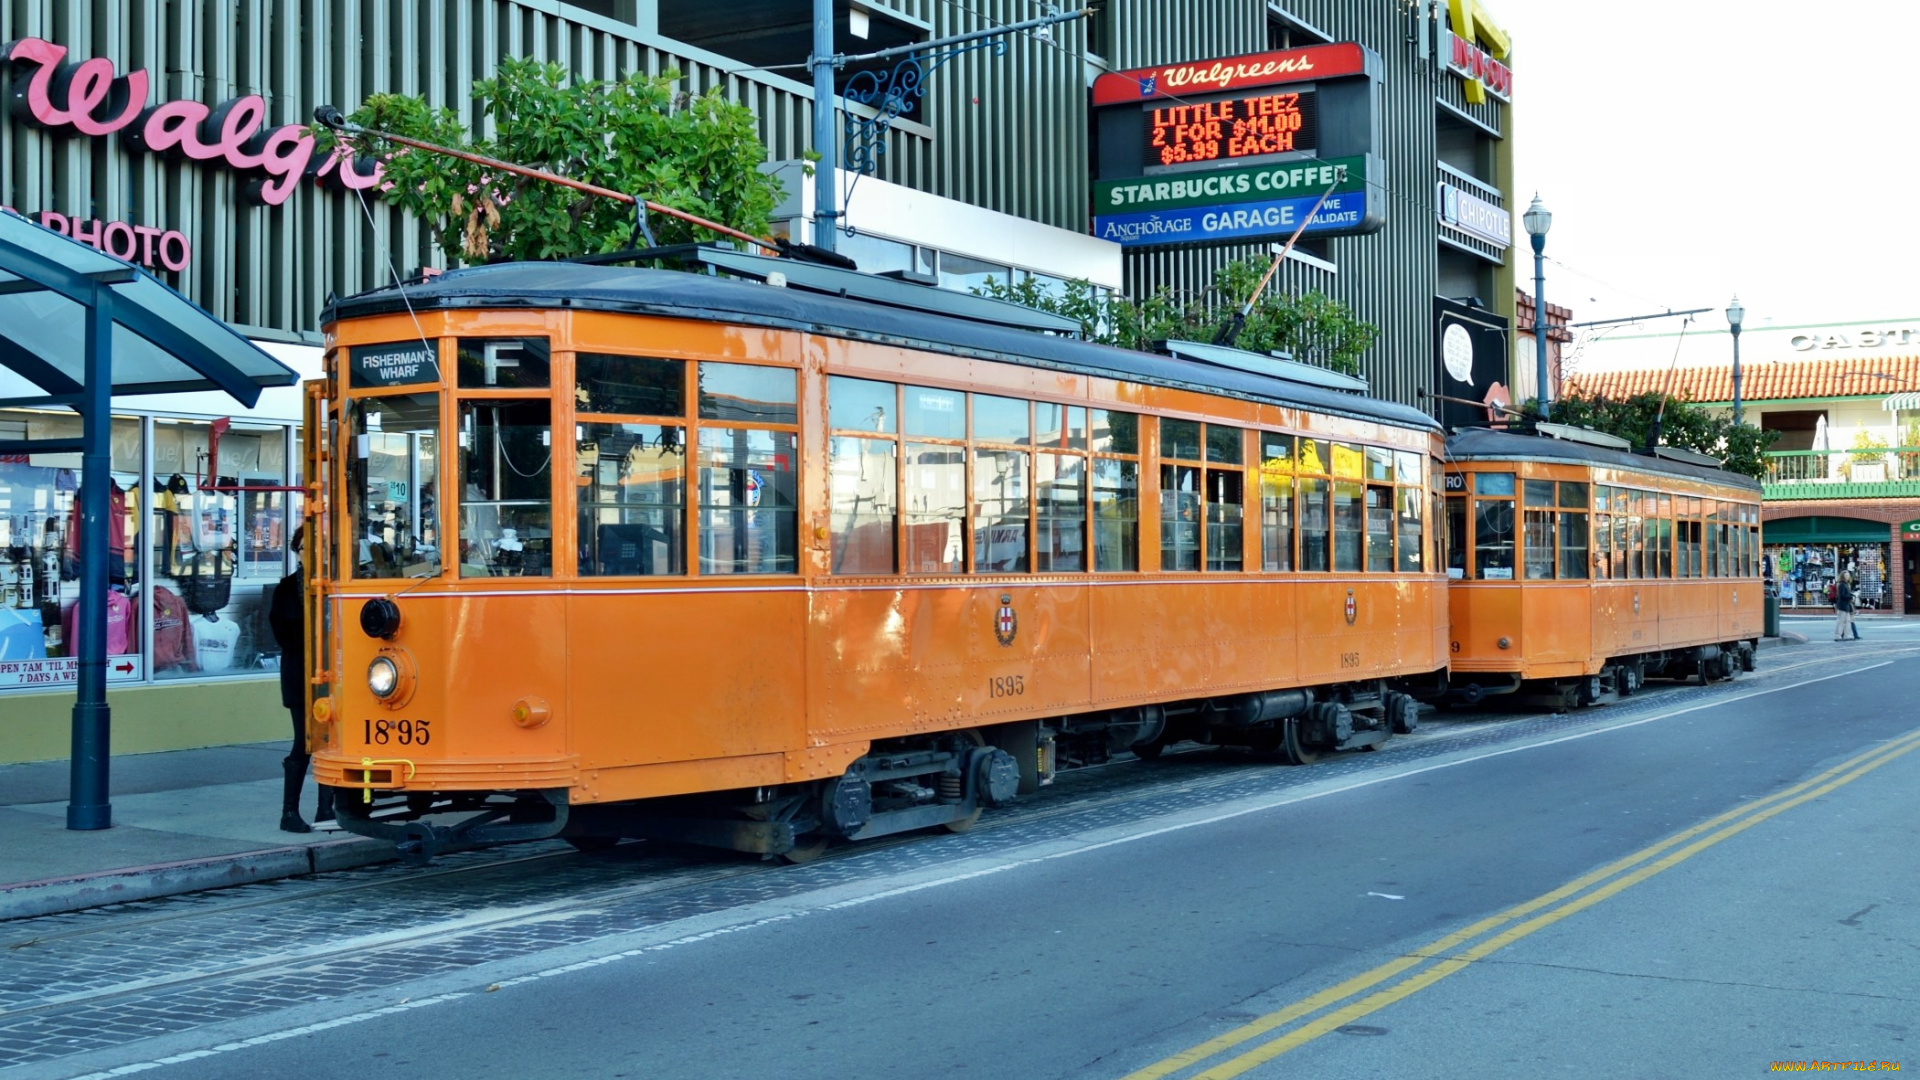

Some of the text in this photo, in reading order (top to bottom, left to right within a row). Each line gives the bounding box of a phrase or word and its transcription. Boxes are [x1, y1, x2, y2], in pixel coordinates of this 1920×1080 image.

[1163, 55, 1314, 88] Walgreens
[1154, 93, 1300, 127] LITTLE TEEZ
[1153, 112, 1303, 147] 2 FOR $11.00
[1160, 132, 1294, 166] $5.99 EACH
[1110, 164, 1349, 206] STARBUCKS COFFEE
[1323, 198, 1341, 210] WE
[1202, 206, 1294, 232] GARAGE
[1460, 200, 1509, 237] CHIPOTLE
[362, 350, 435, 369] FISHERMAN'S
[379, 364, 419, 380] WHARF
[484, 341, 524, 385] F
[23, 662, 42, 672] 7AM
[46, 660, 63, 671] 'TIL
[1340, 651, 1360, 668] 1895
[19, 674, 25, 683] 7
[27, 673, 51, 682] DAYS
[53, 671, 60, 681] A
[989, 675, 1024, 698] 1895
[364, 719, 430, 746] 1895
